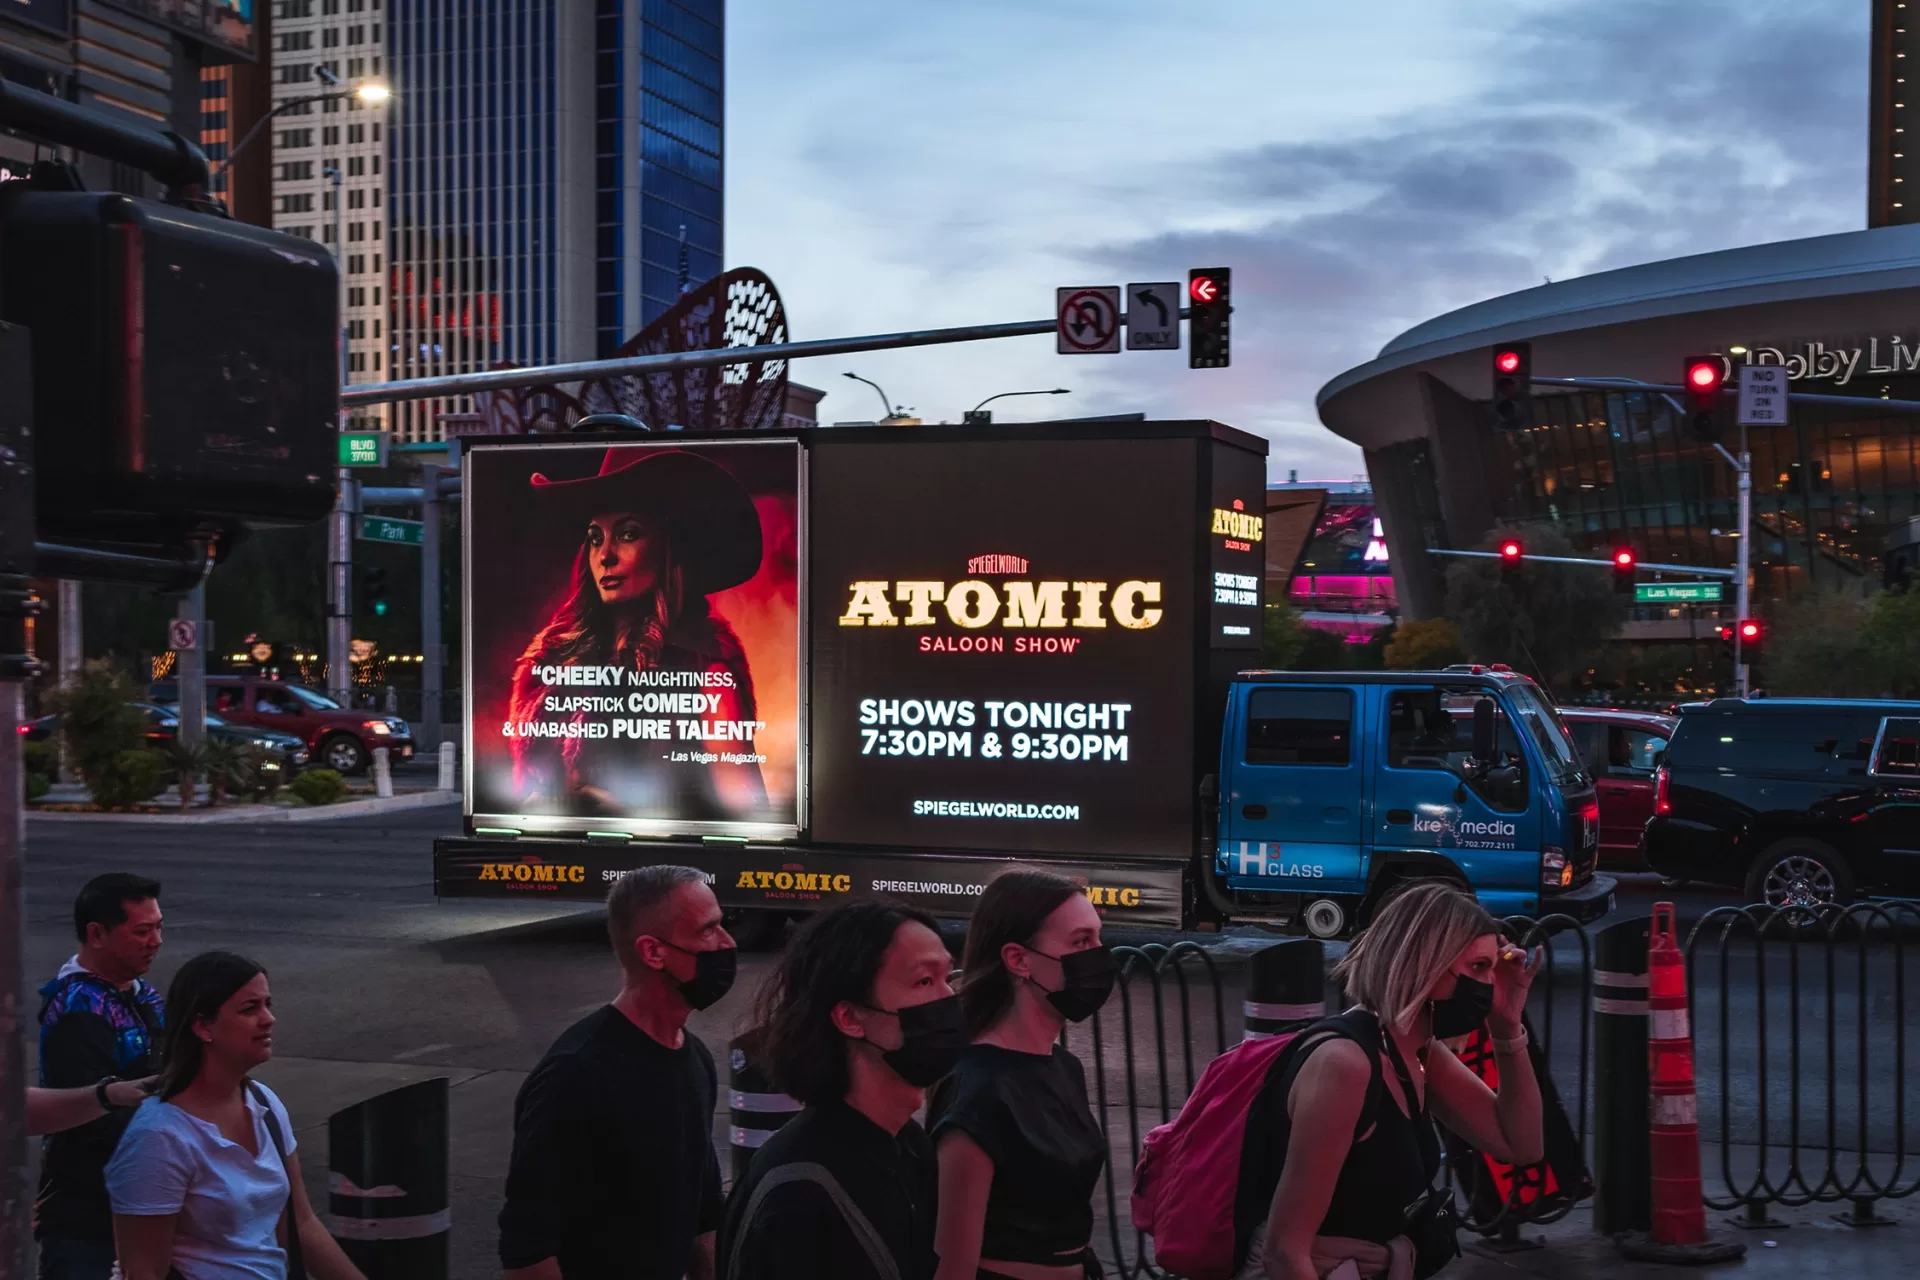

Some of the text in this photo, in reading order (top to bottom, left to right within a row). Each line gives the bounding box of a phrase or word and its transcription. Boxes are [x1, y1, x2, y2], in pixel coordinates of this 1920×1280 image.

[1752, 370, 1776, 382] NO
[1212, 508, 1263, 541] ATOMIC
[968, 554, 1028, 574] SPIEGELWORLD
[1647, 587, 1667, 598] Las
[1667, 587, 1698, 599] Vegas
[839, 580, 1163, 629] ATOMIC
[920, 636, 1077, 653] SALOON SHOW
[628, 671, 737, 690] NAUGHTINESS,
[545, 692, 722, 714] SLAPSTICK COMEDY
[859, 698, 1132, 730] SHOWS TONIGHT
[501, 721, 515, 737] &
[518, 722, 609, 739] UNABASHED
[612, 719, 672, 740] PURE
[861, 729, 1129, 761] 7:30PM & 9:30PM
[671, 751, 688, 762] Las
[690, 751, 719, 765] Vegas
[720, 751, 767, 765] Magazine
[913, 800, 1080, 820] SPIEGELWORLD.COM
[1464, 840, 1516, 850] 702.777.2111
[478, 864, 585, 882] ATOMIC
[1268, 862, 1324, 878] CLASS
[735, 871, 851, 892] ATOMIC
[871, 879, 988, 896] SPIEGELWORLD.CO
